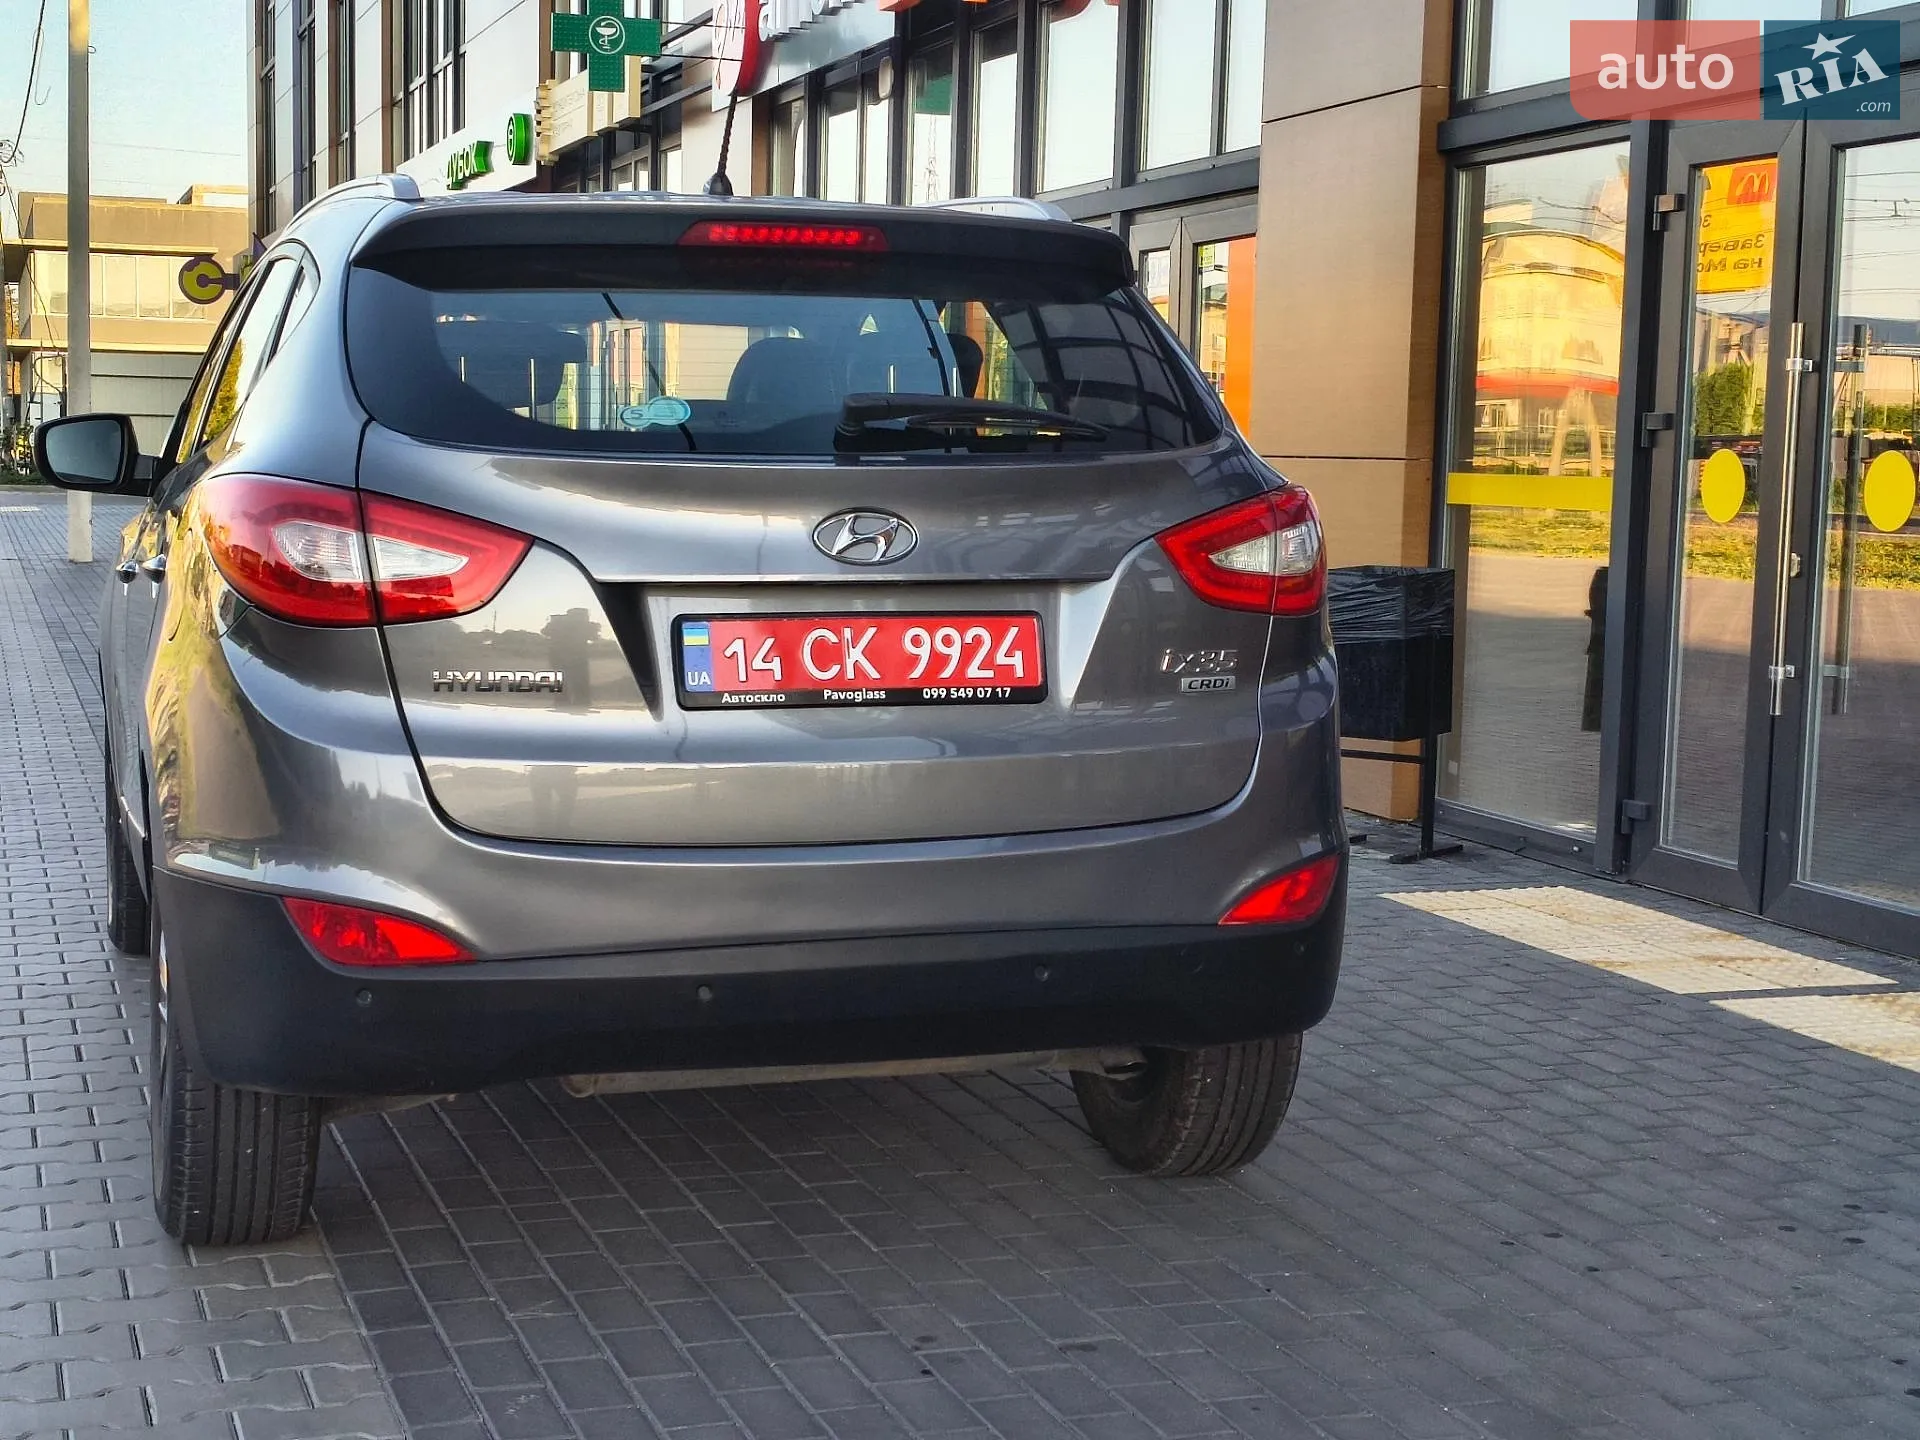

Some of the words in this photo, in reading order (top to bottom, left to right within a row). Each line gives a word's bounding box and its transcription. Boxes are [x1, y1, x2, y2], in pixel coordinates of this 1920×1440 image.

[723, 637, 782, 682] 14
[802, 627, 881, 680] CK
[902, 626, 1025, 679] 9924
[432, 670, 563, 692] HYUNDAI
[687, 671, 711, 685] UA
[1188, 678, 1230, 690] CRDi
[721, 692, 786, 704] Автоскло
[823, 688, 886, 702] Pavoglass
[922, 688, 947, 699] 099
[951, 687, 973, 699] 549
[977, 687, 992, 698] 07
[996, 687, 1011, 698] 17
